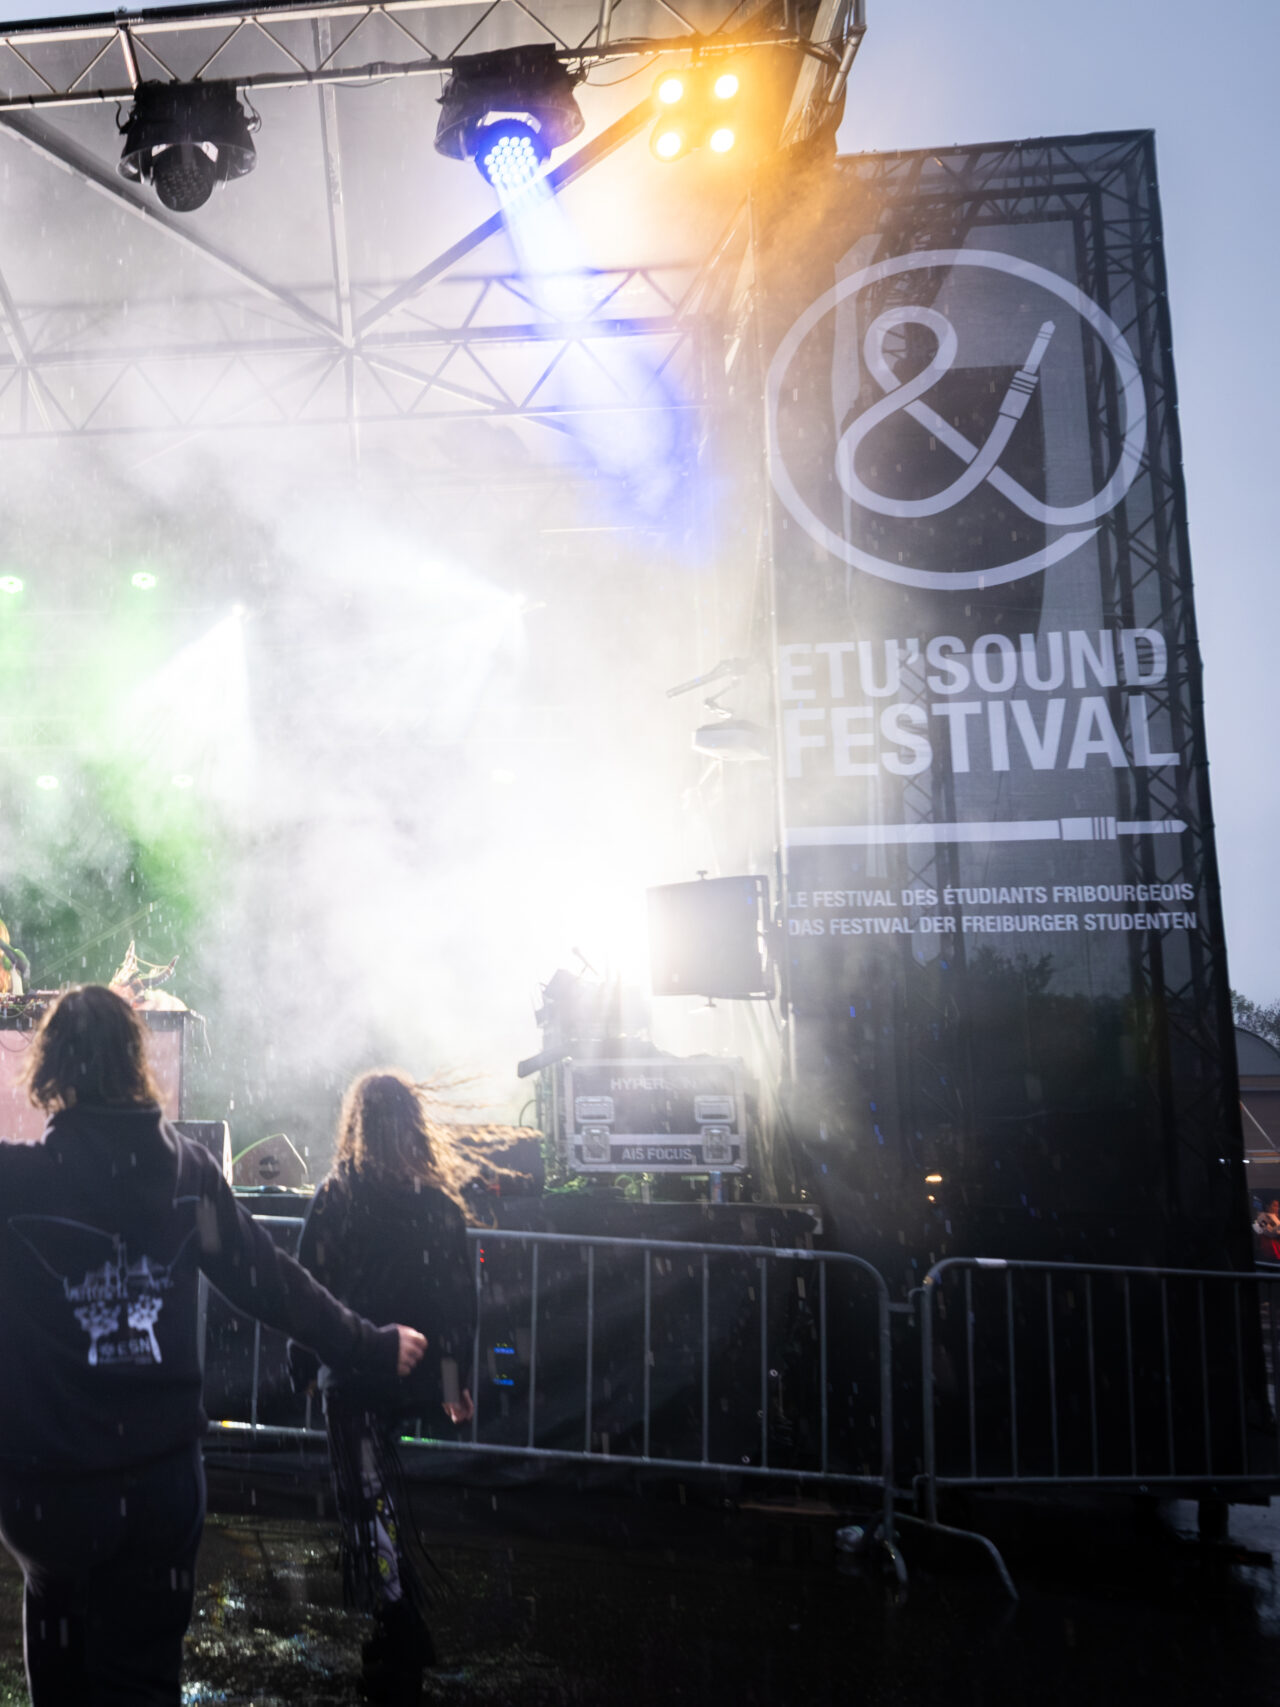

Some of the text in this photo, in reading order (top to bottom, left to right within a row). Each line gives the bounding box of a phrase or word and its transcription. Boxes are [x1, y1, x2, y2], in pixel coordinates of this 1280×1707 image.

[778, 627, 1168, 699] ETU'SOUND
[783, 695, 1180, 778] FESTIVAL
[788, 891, 809, 908] LE
[813, 888, 898, 908] FESTIVAL
[901, 888, 938, 906] DES
[1052, 883, 1195, 903] FRIBOURGEOIS
[788, 912, 1197, 936] DAS FESTIVAL DER FREIBURGER STUDENTEN
[621, 1147, 693, 1161] AIS FOCUS
